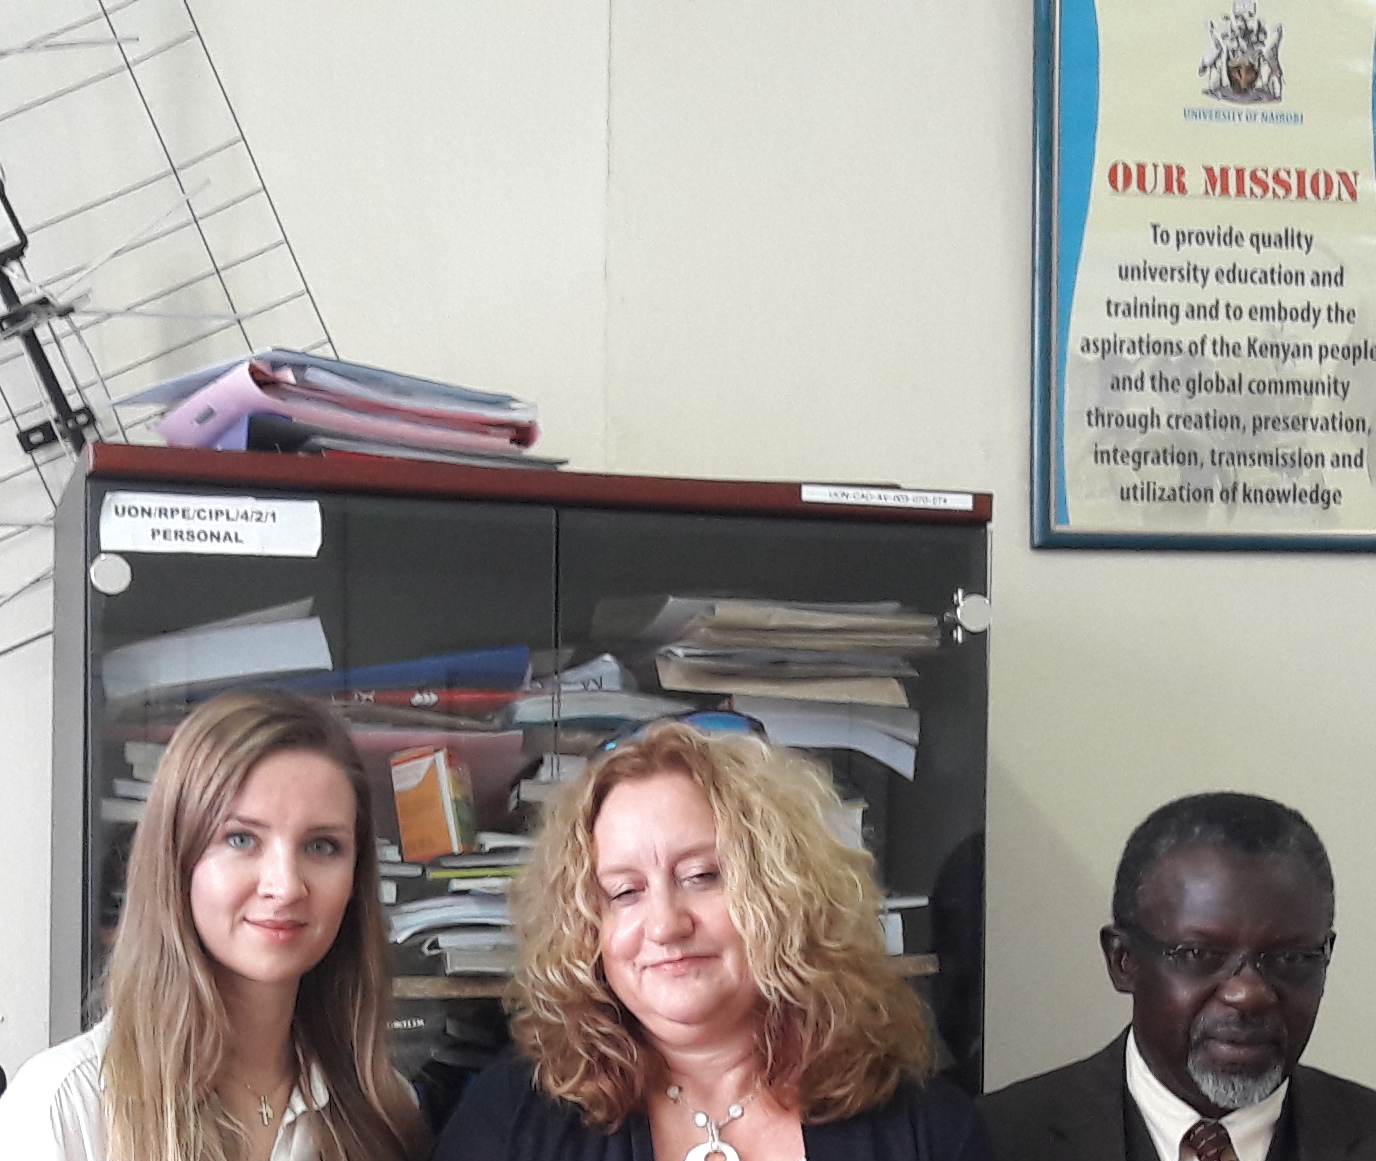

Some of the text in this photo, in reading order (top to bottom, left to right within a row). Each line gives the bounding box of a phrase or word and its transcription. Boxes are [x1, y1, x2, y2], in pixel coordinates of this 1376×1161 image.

[1108, 162, 1360, 202] OUR MISSION
[1151, 223, 1313, 254] To provide quality
[1118, 261, 1344, 289] university education and
[1106, 297, 1356, 328] training and to embody the
[1080, 334, 1183, 358] aspirations
[1188, 335, 1208, 358] of
[1212, 337, 1242, 358] the
[1247, 338, 1313, 363] Kenyan
[1110, 371, 1350, 401] and the global community
[1086, 408, 1372, 436] through creation, preservation,
[1094, 444, 1364, 470] integration, transmission and
[1120, 481, 1342, 509] utilization of knowledge
[151, 528, 243, 544] PERSONAL
